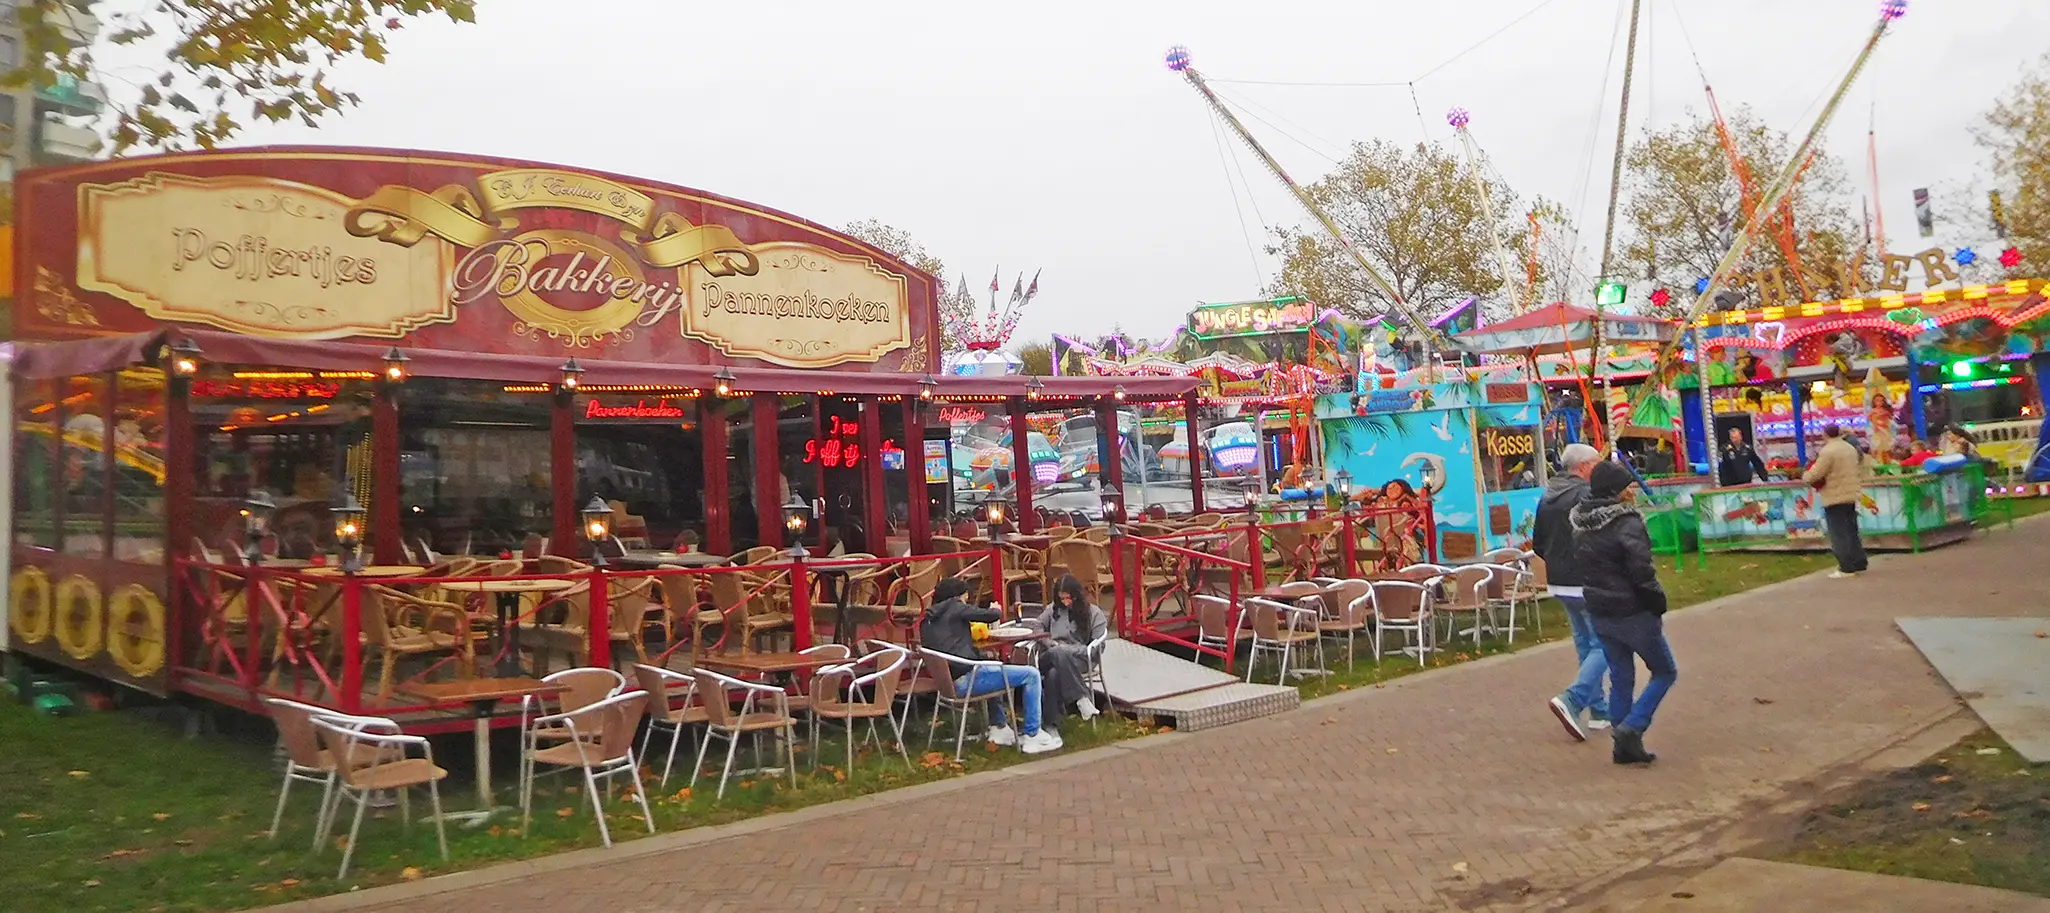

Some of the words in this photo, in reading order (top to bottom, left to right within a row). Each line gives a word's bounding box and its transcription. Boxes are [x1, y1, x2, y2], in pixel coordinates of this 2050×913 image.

[171, 227, 378, 289] Poffertjes
[451, 237, 684, 327] Bakkerij
[701, 281, 890, 325] Pannenkoeken
[1193, 305, 1253, 334] JUNGLE
[586, 399, 685, 419] Pannenkoeken
[1486, 429, 1535, 456] Kassa
